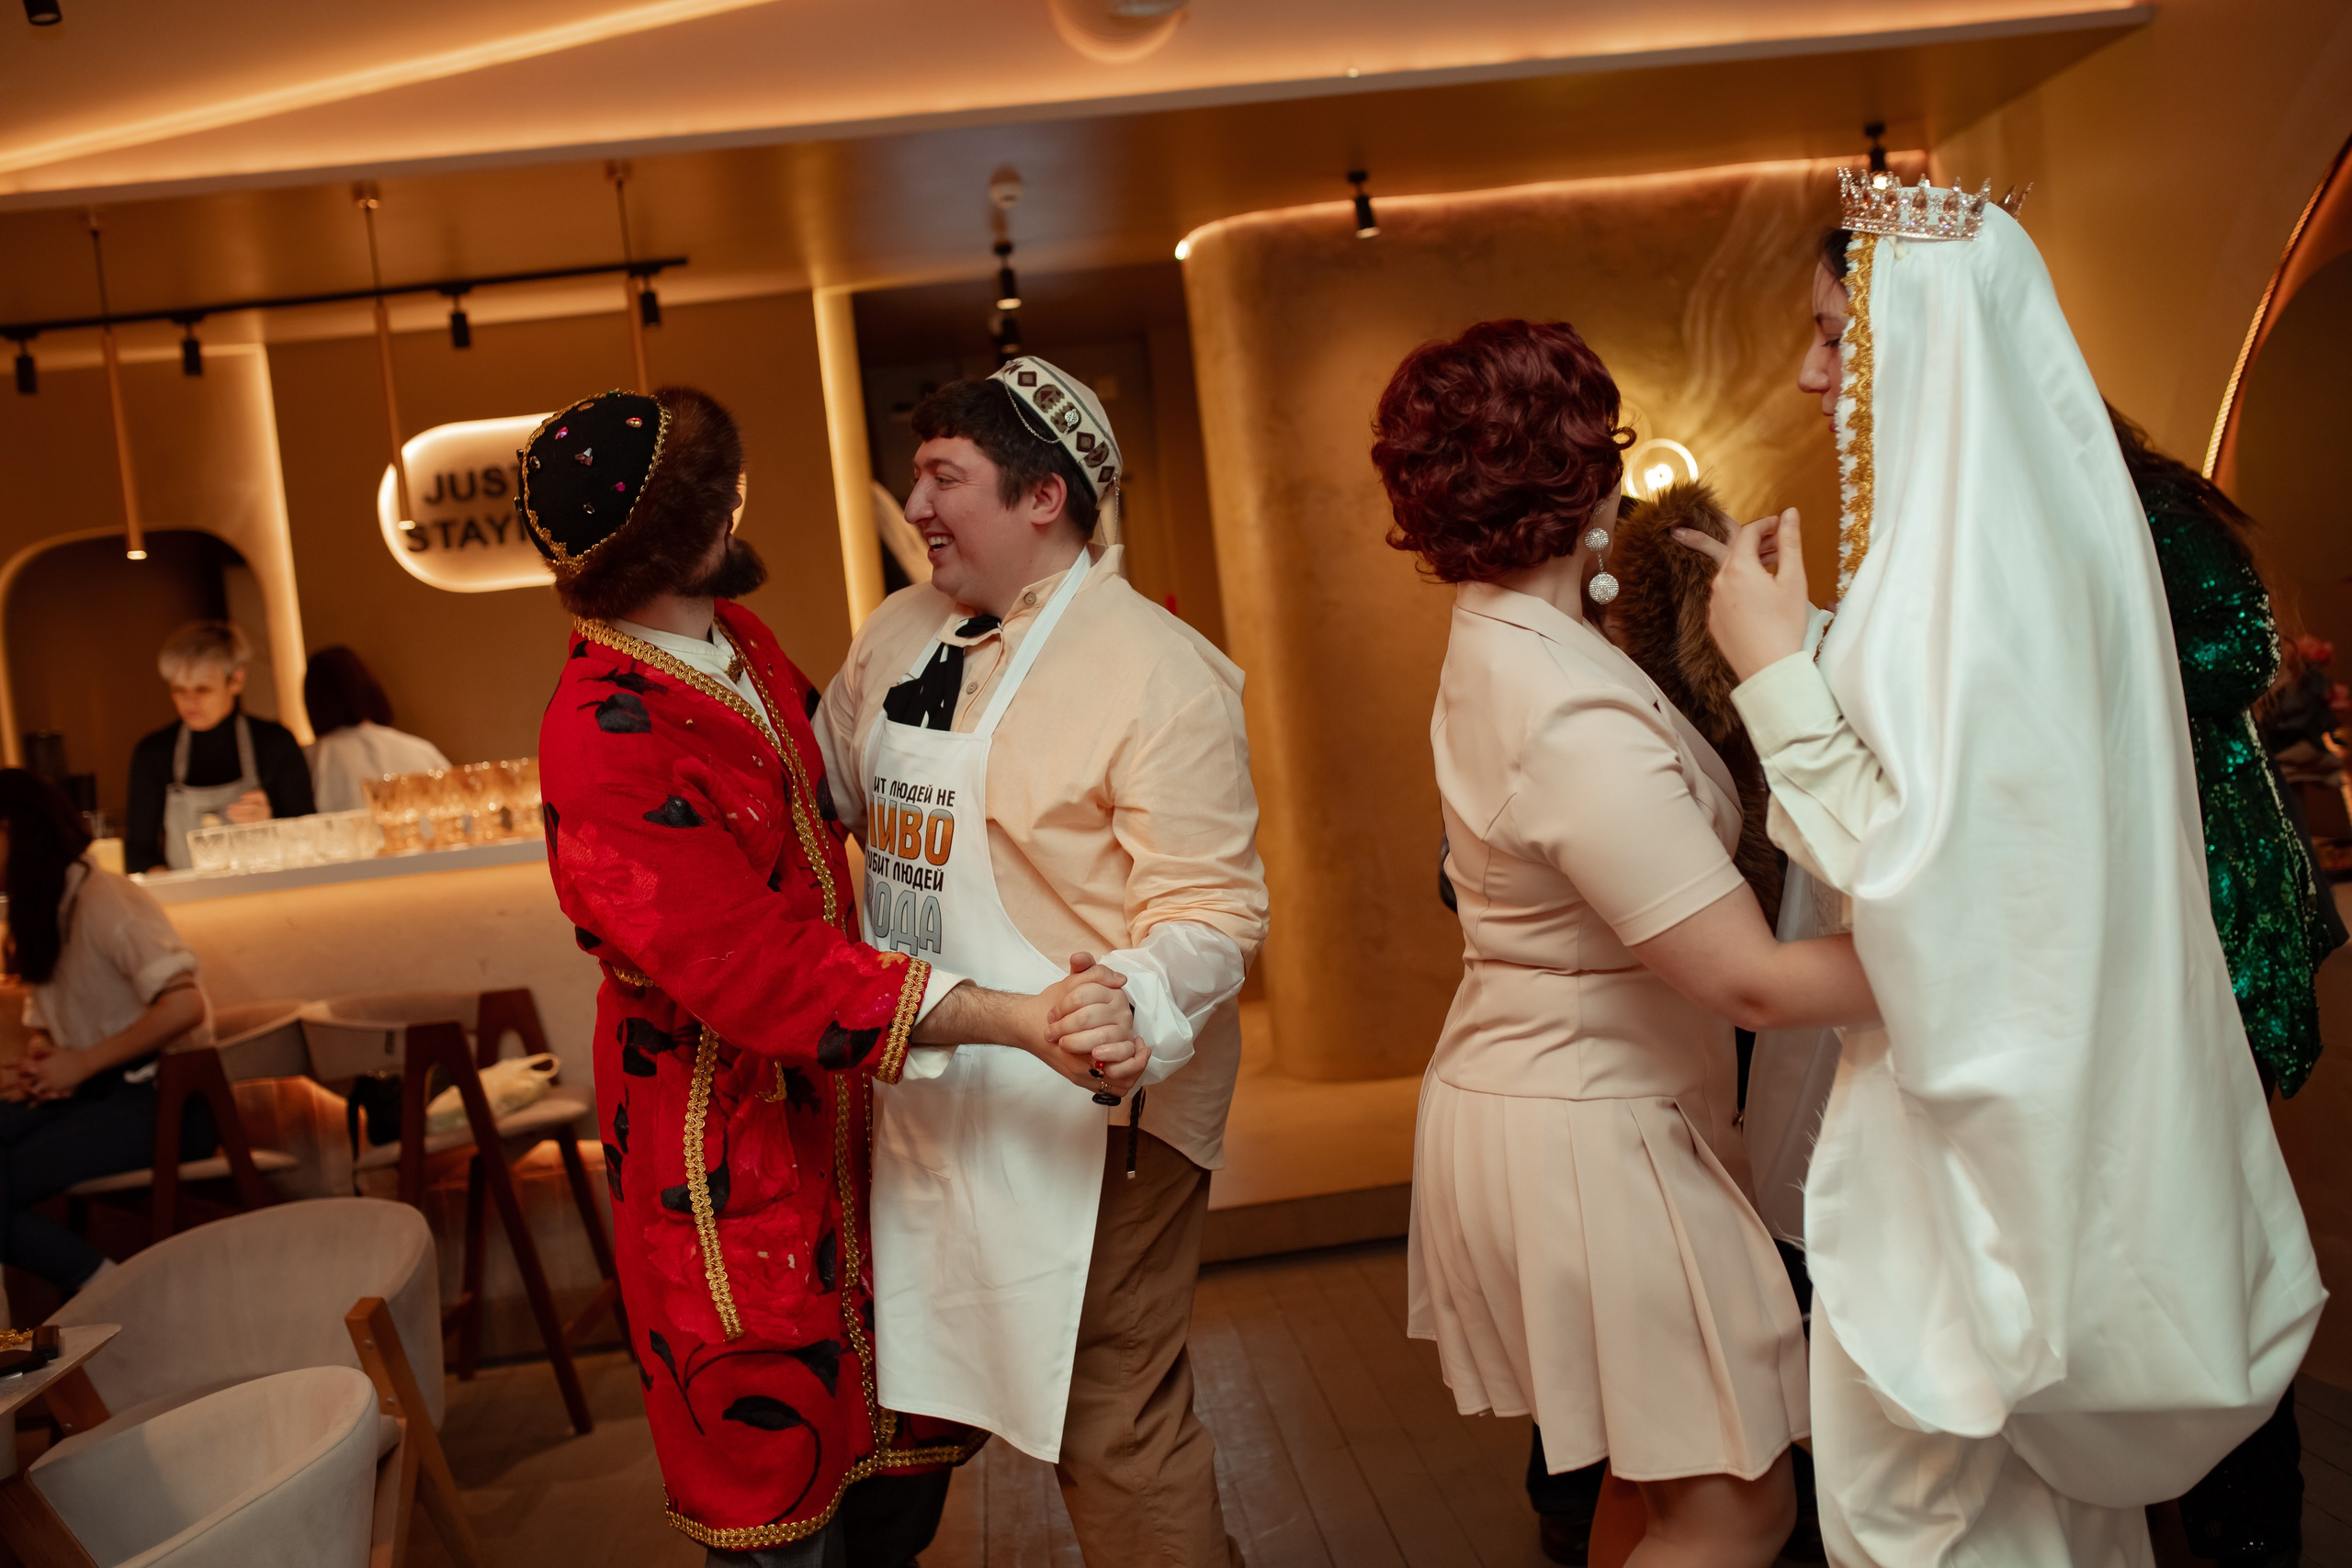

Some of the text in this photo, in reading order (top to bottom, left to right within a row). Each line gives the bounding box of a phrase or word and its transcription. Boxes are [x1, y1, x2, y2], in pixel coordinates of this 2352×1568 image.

[889, 780, 933, 804] ЛЮДЕЙ
[936, 788, 956, 807] НЕ
[893, 861, 944, 892] ЛЮДЕЙ
